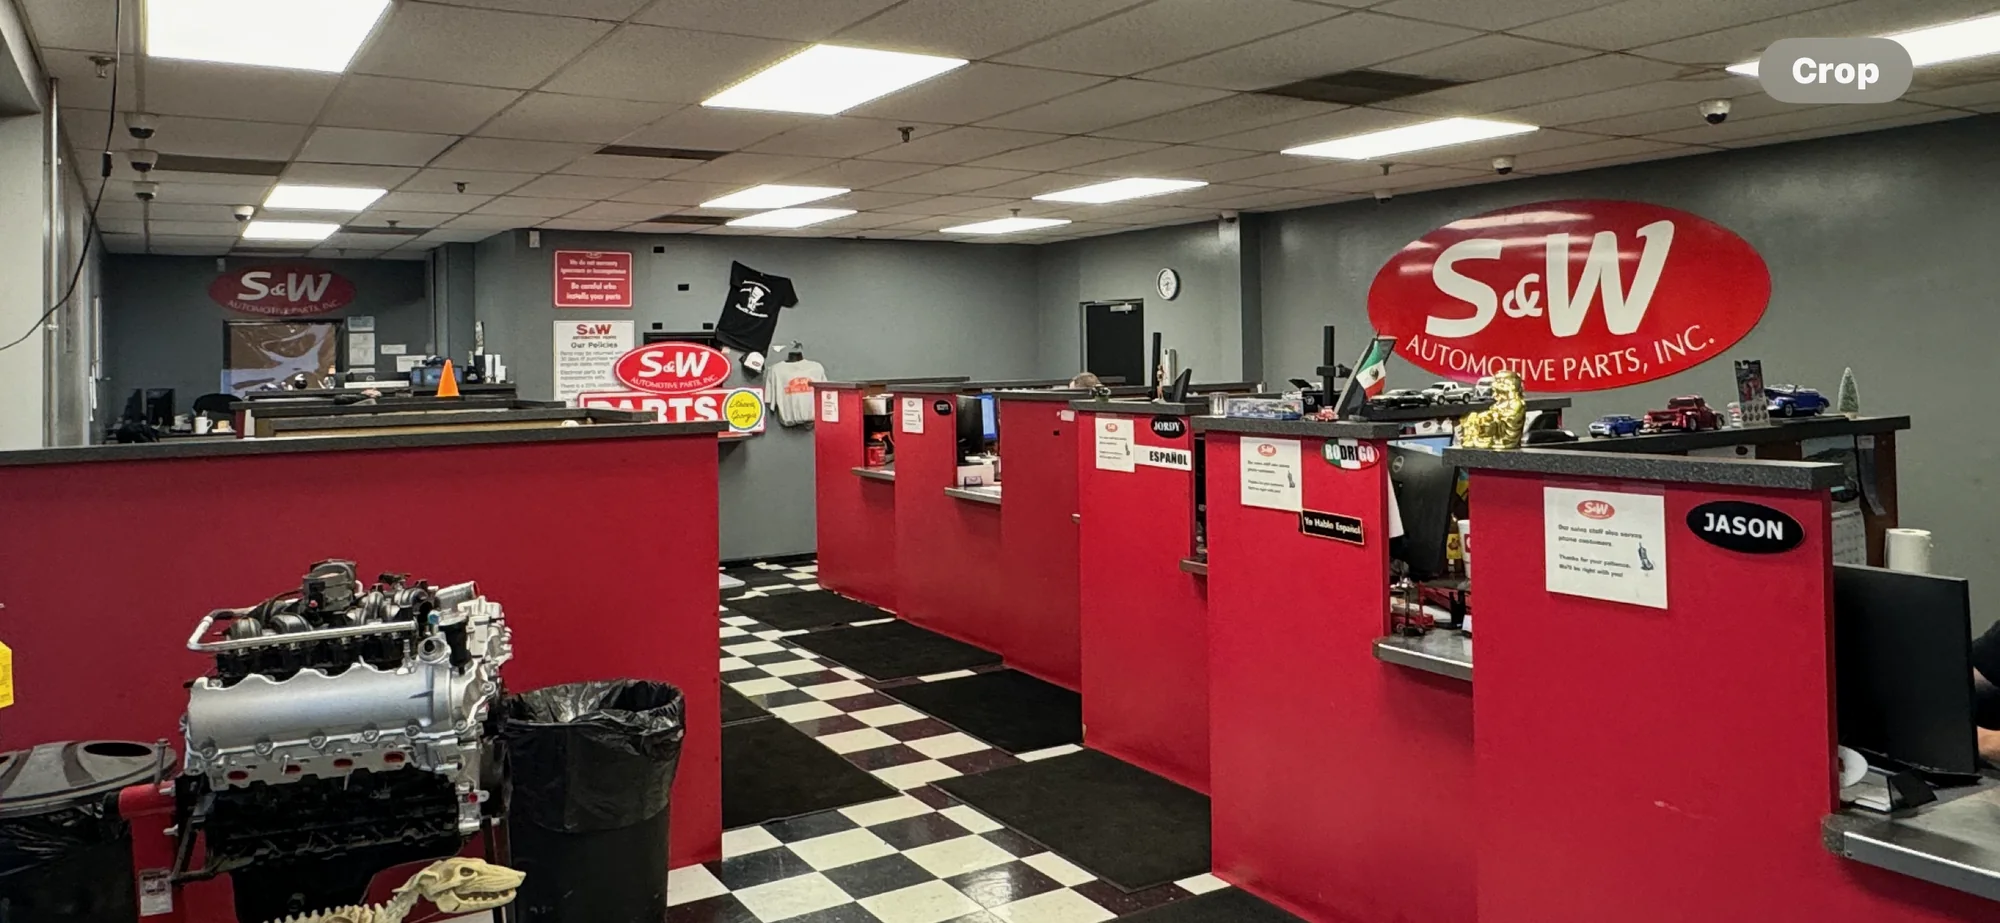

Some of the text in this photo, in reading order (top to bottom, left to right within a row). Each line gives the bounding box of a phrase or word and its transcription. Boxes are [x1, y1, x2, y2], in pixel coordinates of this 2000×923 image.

[1425, 220, 1675, 337] S&W
[236, 271, 332, 302] S&W
[576, 323, 612, 335] S&W
[570, 341, 618, 349] Our Policies
[1406, 324, 1715, 381] AUTOMOTIVE PARTS, INC.
[638, 350, 710, 378] S&W
[630, 376, 678, 389] AUTOMOTIVE
[1153, 421, 1181, 432] JORDY
[1149, 450, 1188, 466] ESPAÑOL
[1325, 444, 1375, 463] RODRIGO
[1583, 501, 1609, 515] S&W
[1304, 516, 1361, 534] Yo Hablo Español
[1703, 512, 1783, 540] JASON
[1558, 535, 1577, 544] phone
[1605, 529, 1619, 537] also
[1559, 553, 1579, 562] Thanks
